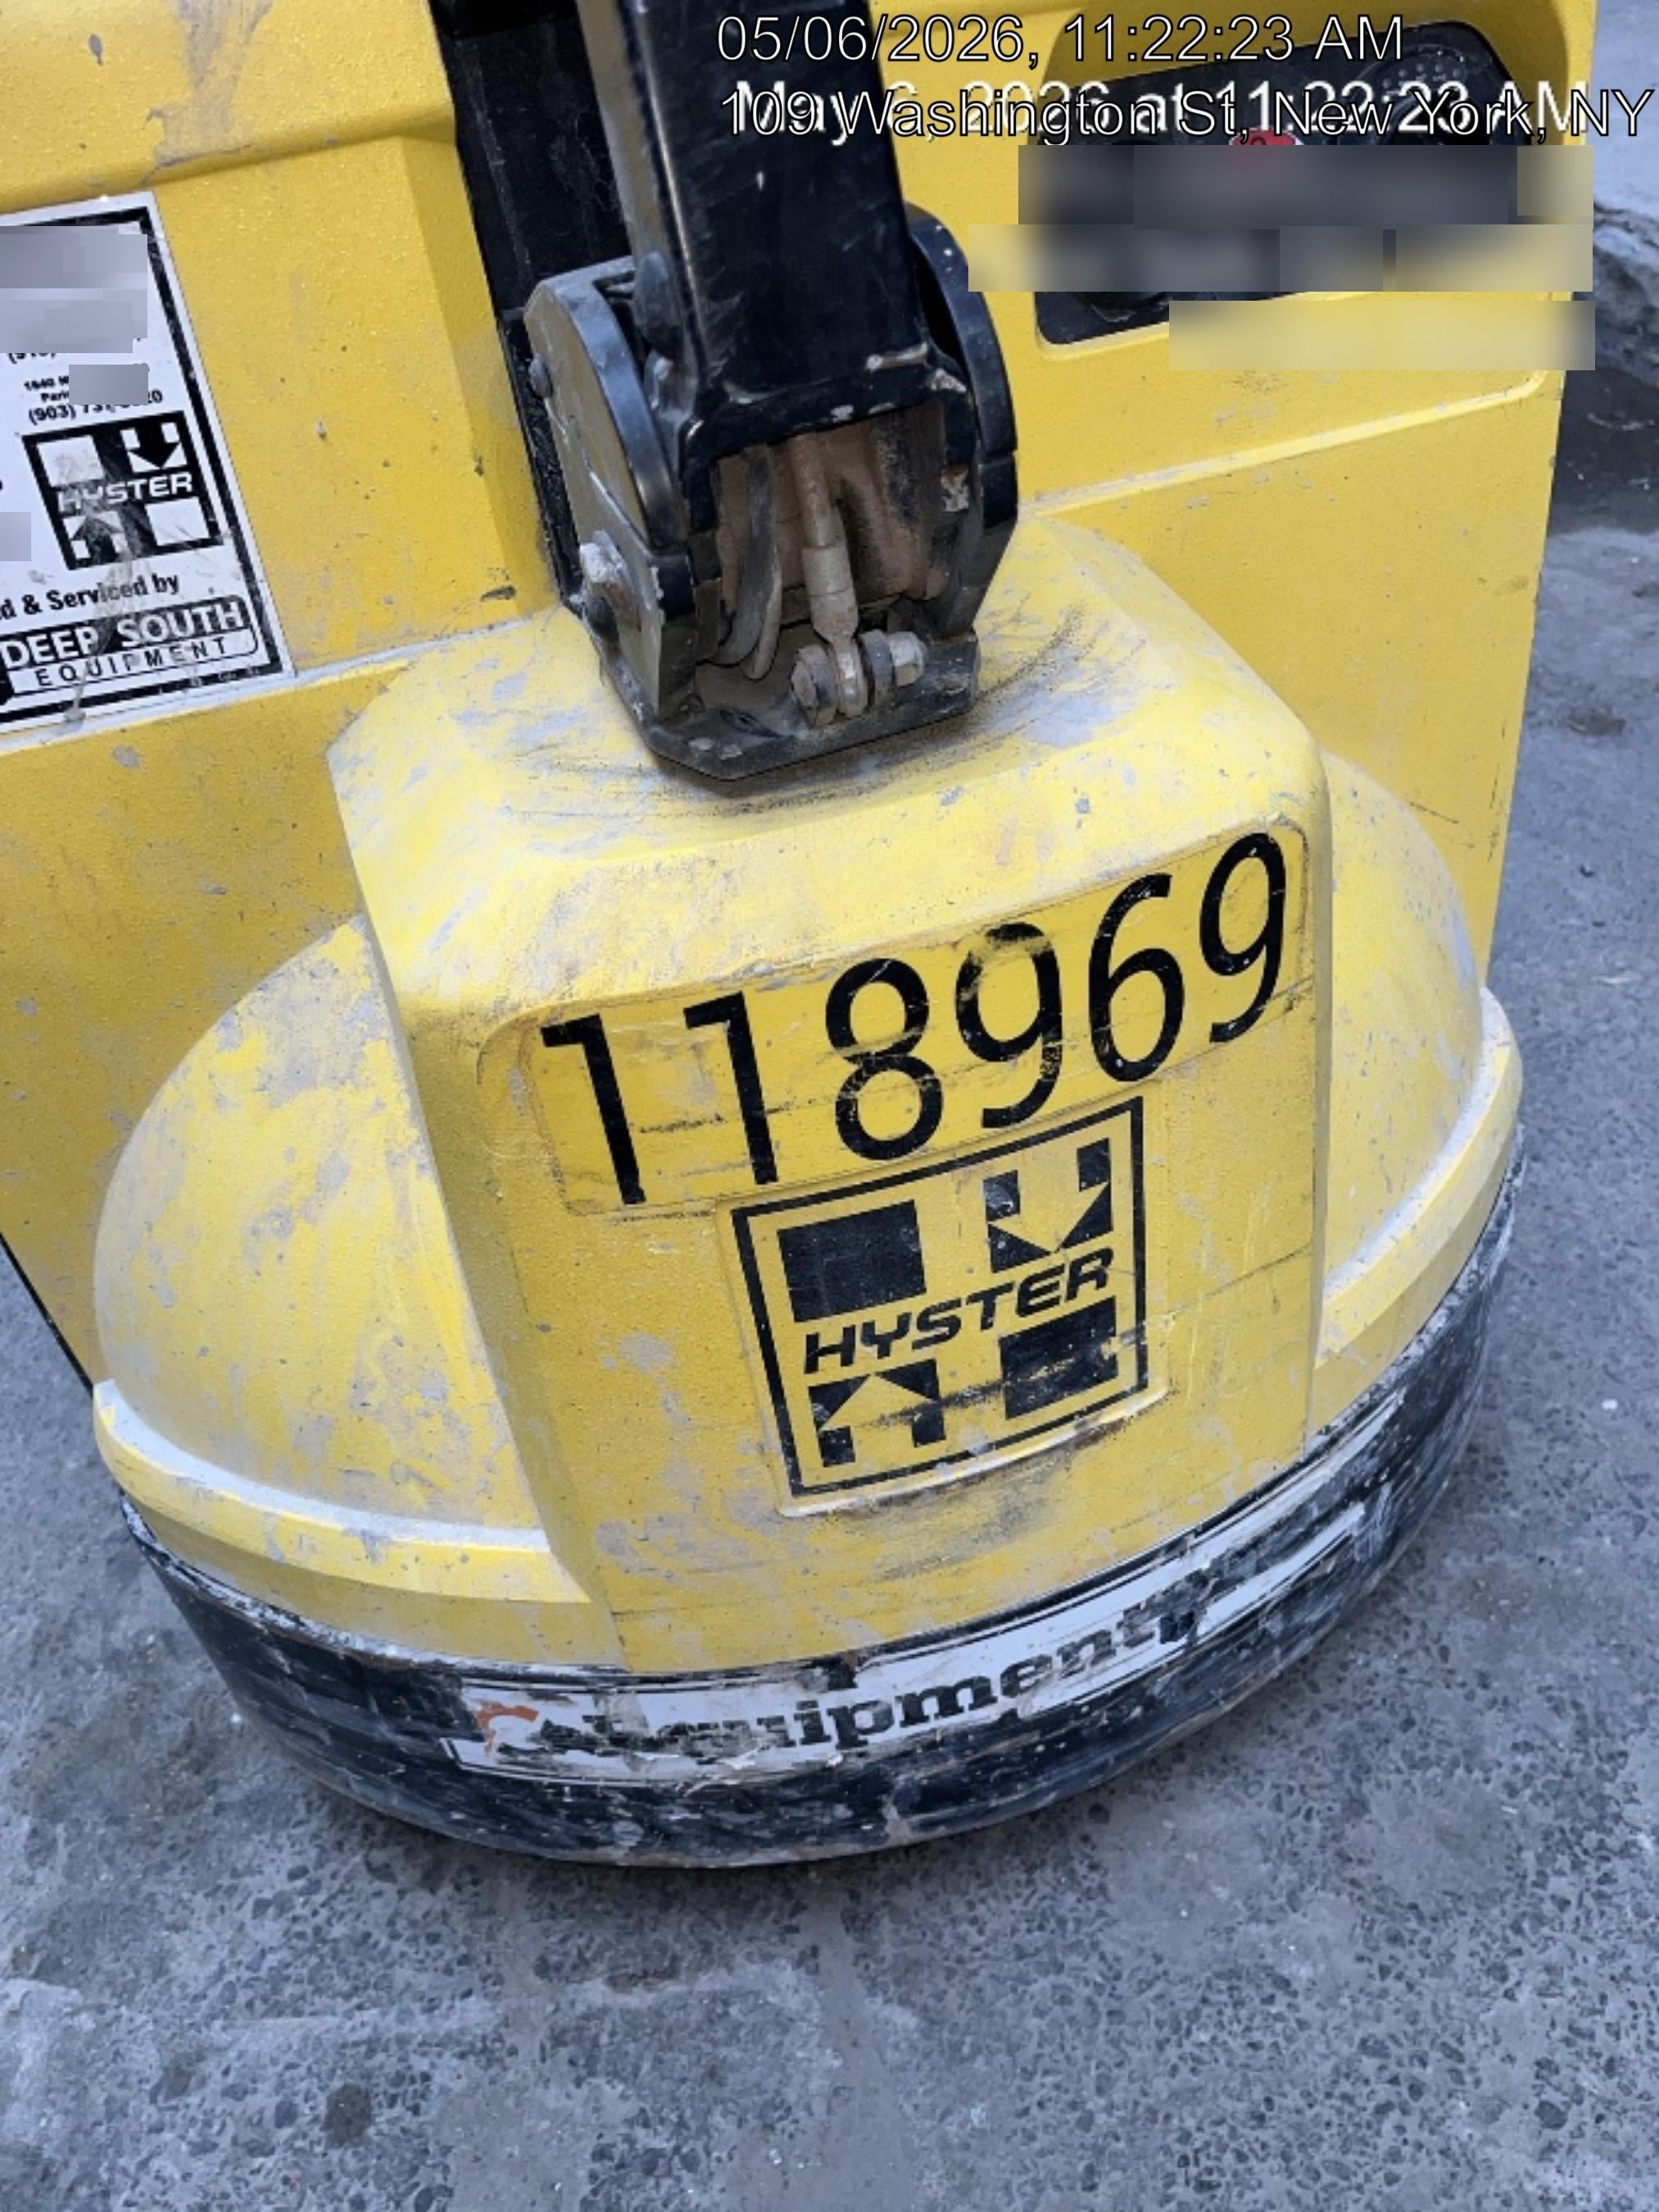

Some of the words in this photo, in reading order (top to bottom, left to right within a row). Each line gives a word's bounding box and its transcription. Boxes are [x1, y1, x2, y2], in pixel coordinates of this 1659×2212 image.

[57, 472, 193, 513] HYSTER
[22, 593, 42, 614] &
[46, 574, 147, 610] Serviced
[152, 573, 179, 595] by
[0, 625, 100, 669] DEEP
[117, 601, 245, 646] SOUTH
[34, 636, 226, 687] EQUIPMENT
[541, 832, 1287, 1206] 118969
[804, 1247, 1114, 1376] HYSTER
